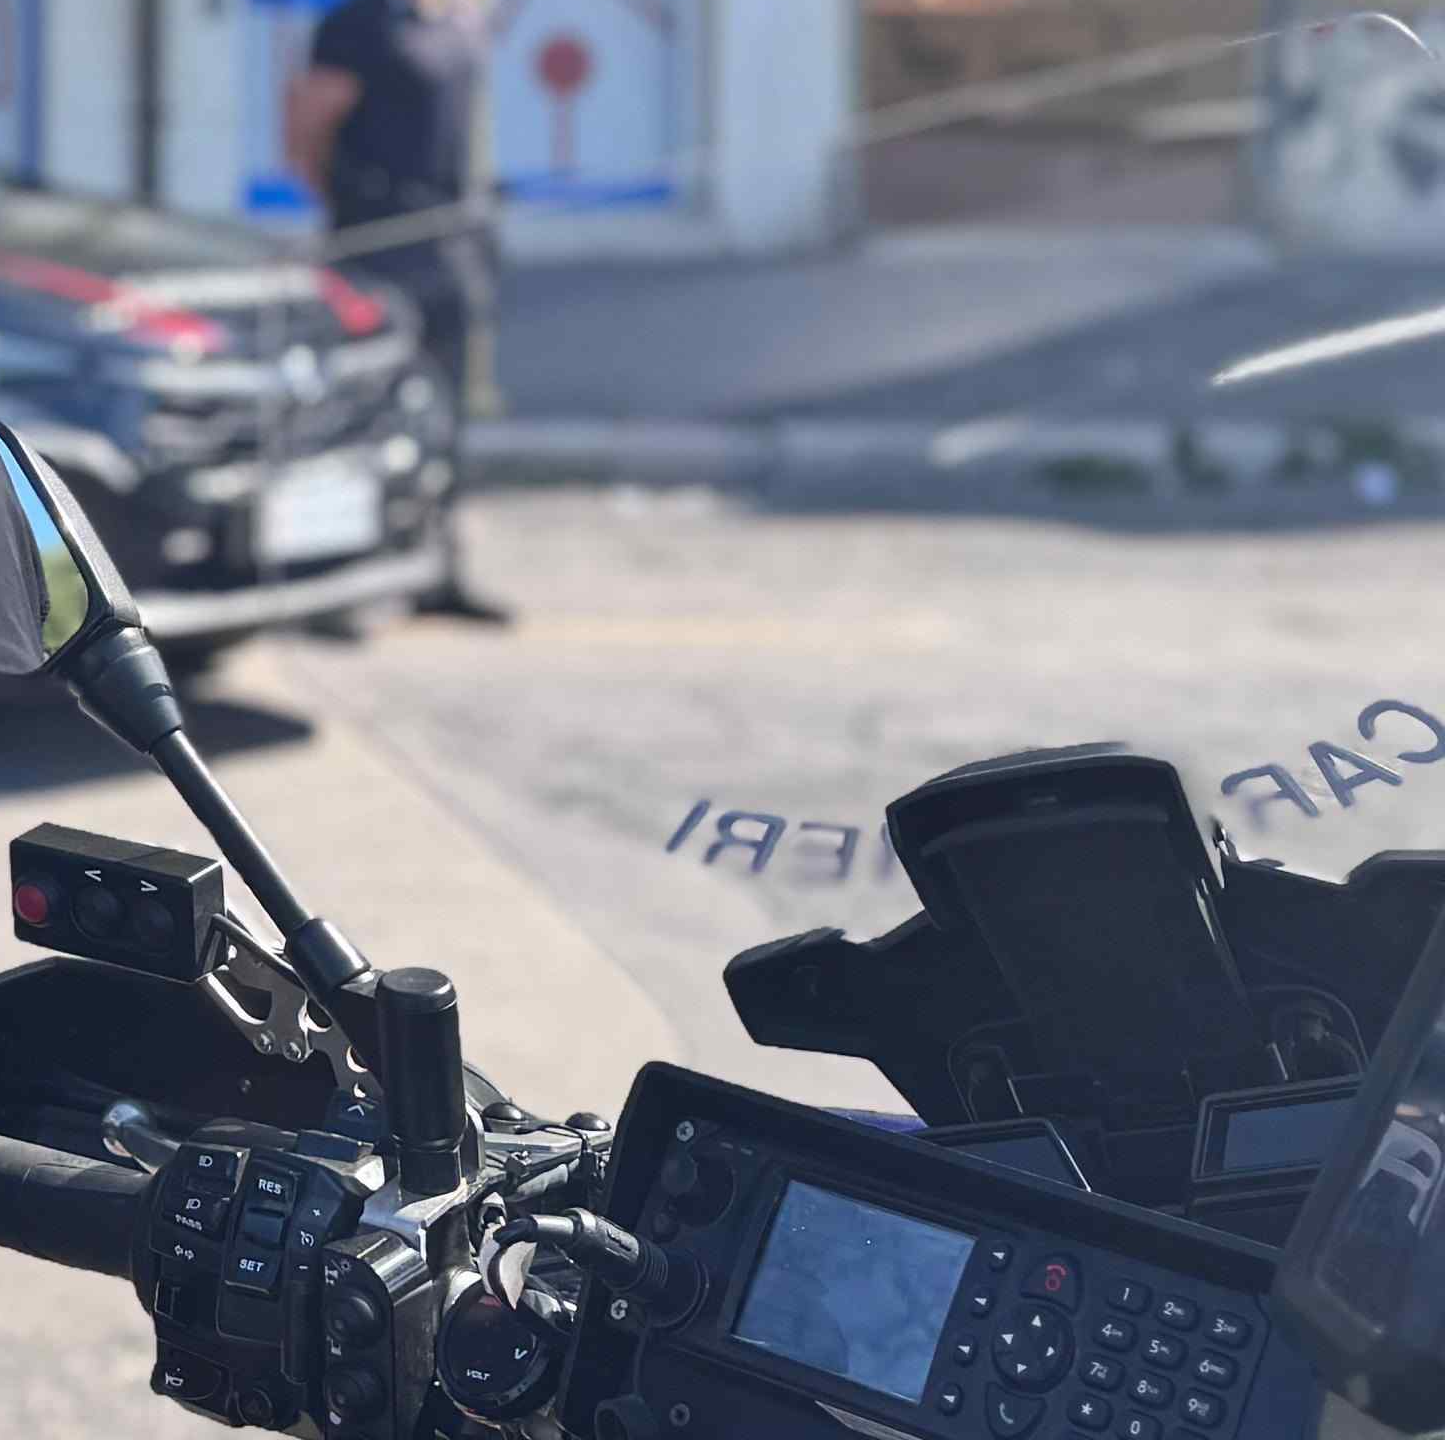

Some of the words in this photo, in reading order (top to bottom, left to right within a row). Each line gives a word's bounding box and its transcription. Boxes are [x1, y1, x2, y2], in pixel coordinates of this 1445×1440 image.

[258, 1178, 282, 1195] RES
[174, 1213, 203, 1231] PASS
[239, 1259, 264, 1272] SET
[514, 1347, 527, 1360] V
[466, 1368, 490, 1381] VOLT
[1130, 1420, 1141, 1435] 0
